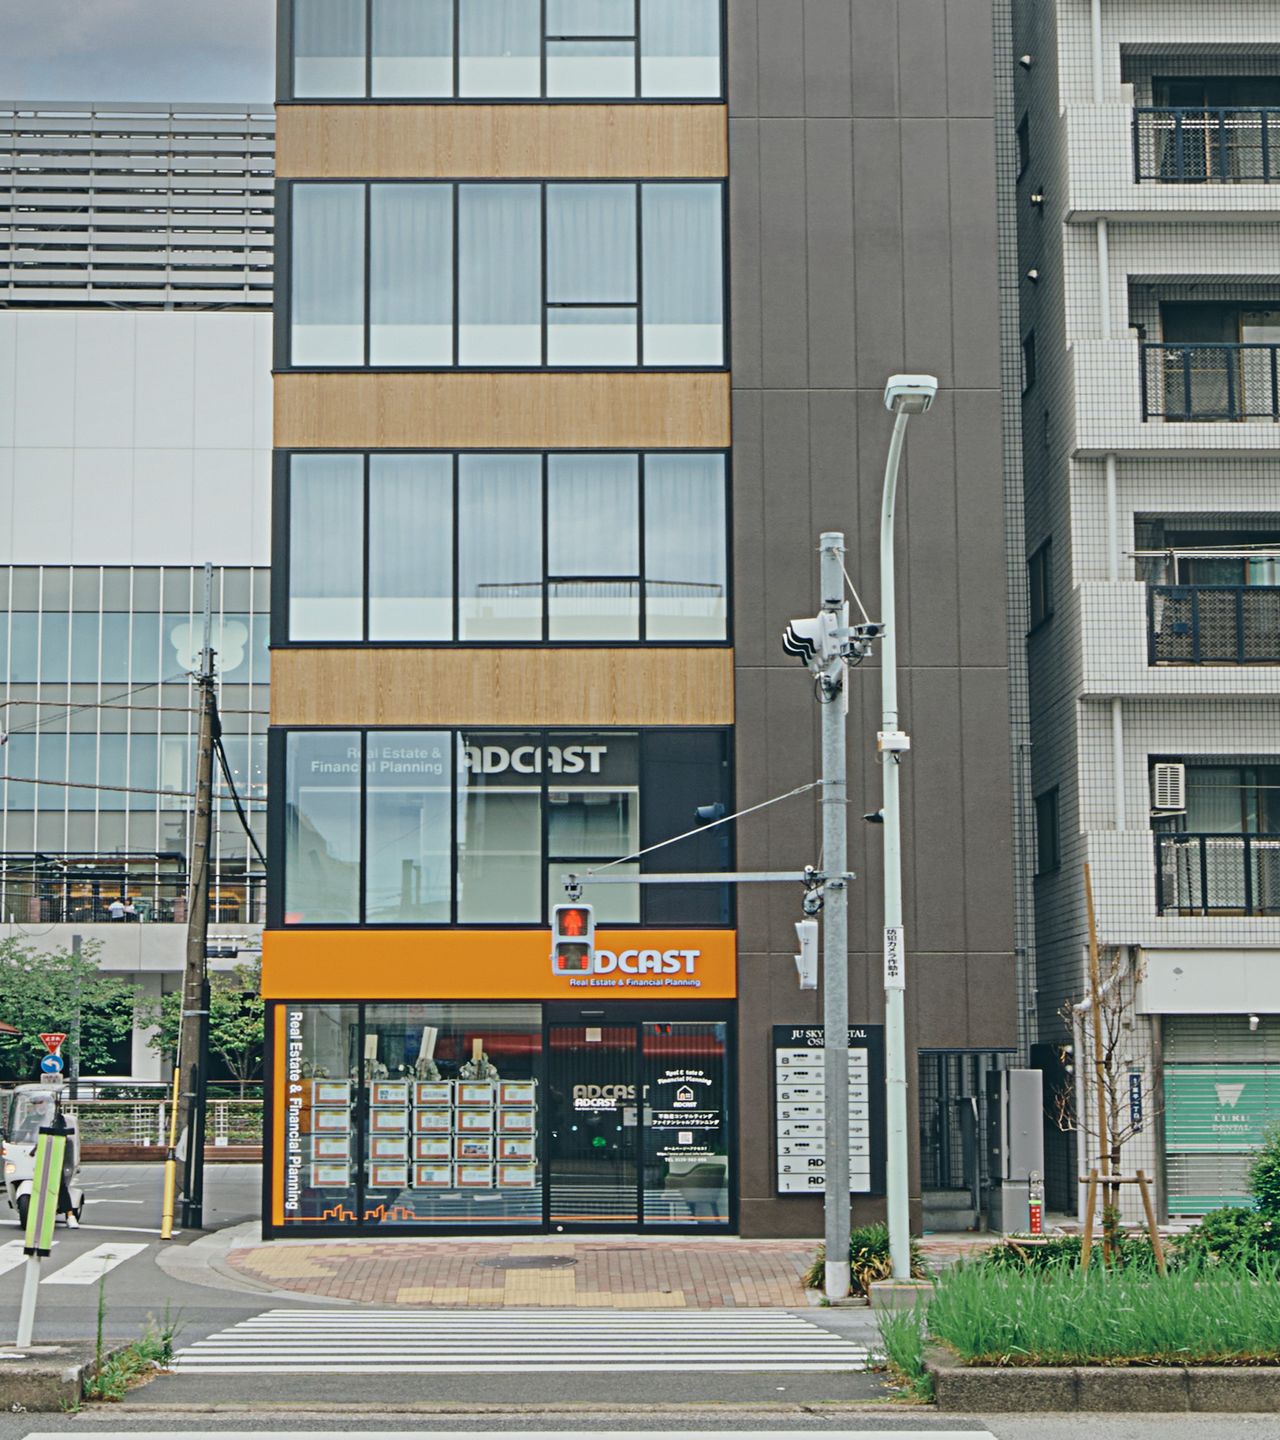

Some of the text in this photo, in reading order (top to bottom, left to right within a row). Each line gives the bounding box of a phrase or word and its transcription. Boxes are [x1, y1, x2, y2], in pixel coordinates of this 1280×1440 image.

[383, 747, 429, 759] Estate
[431, 747, 442, 759] &
[310, 761, 443, 774] Financal Planning
[593, 949, 701, 974] DCAST
[665, 979, 701, 987] Planning
[791, 1029, 804, 1039] JU
[781, 1057, 790, 1065] 8
[782, 1074, 789, 1082] 7
[782, 1092, 790, 1100] 6
[285, 1011, 304, 1210] Real Estate & Financial Planning
[782, 1111, 791, 1119] 5
[783, 1146, 791, 1154] 3
[786, 1182, 790, 1190] 1
